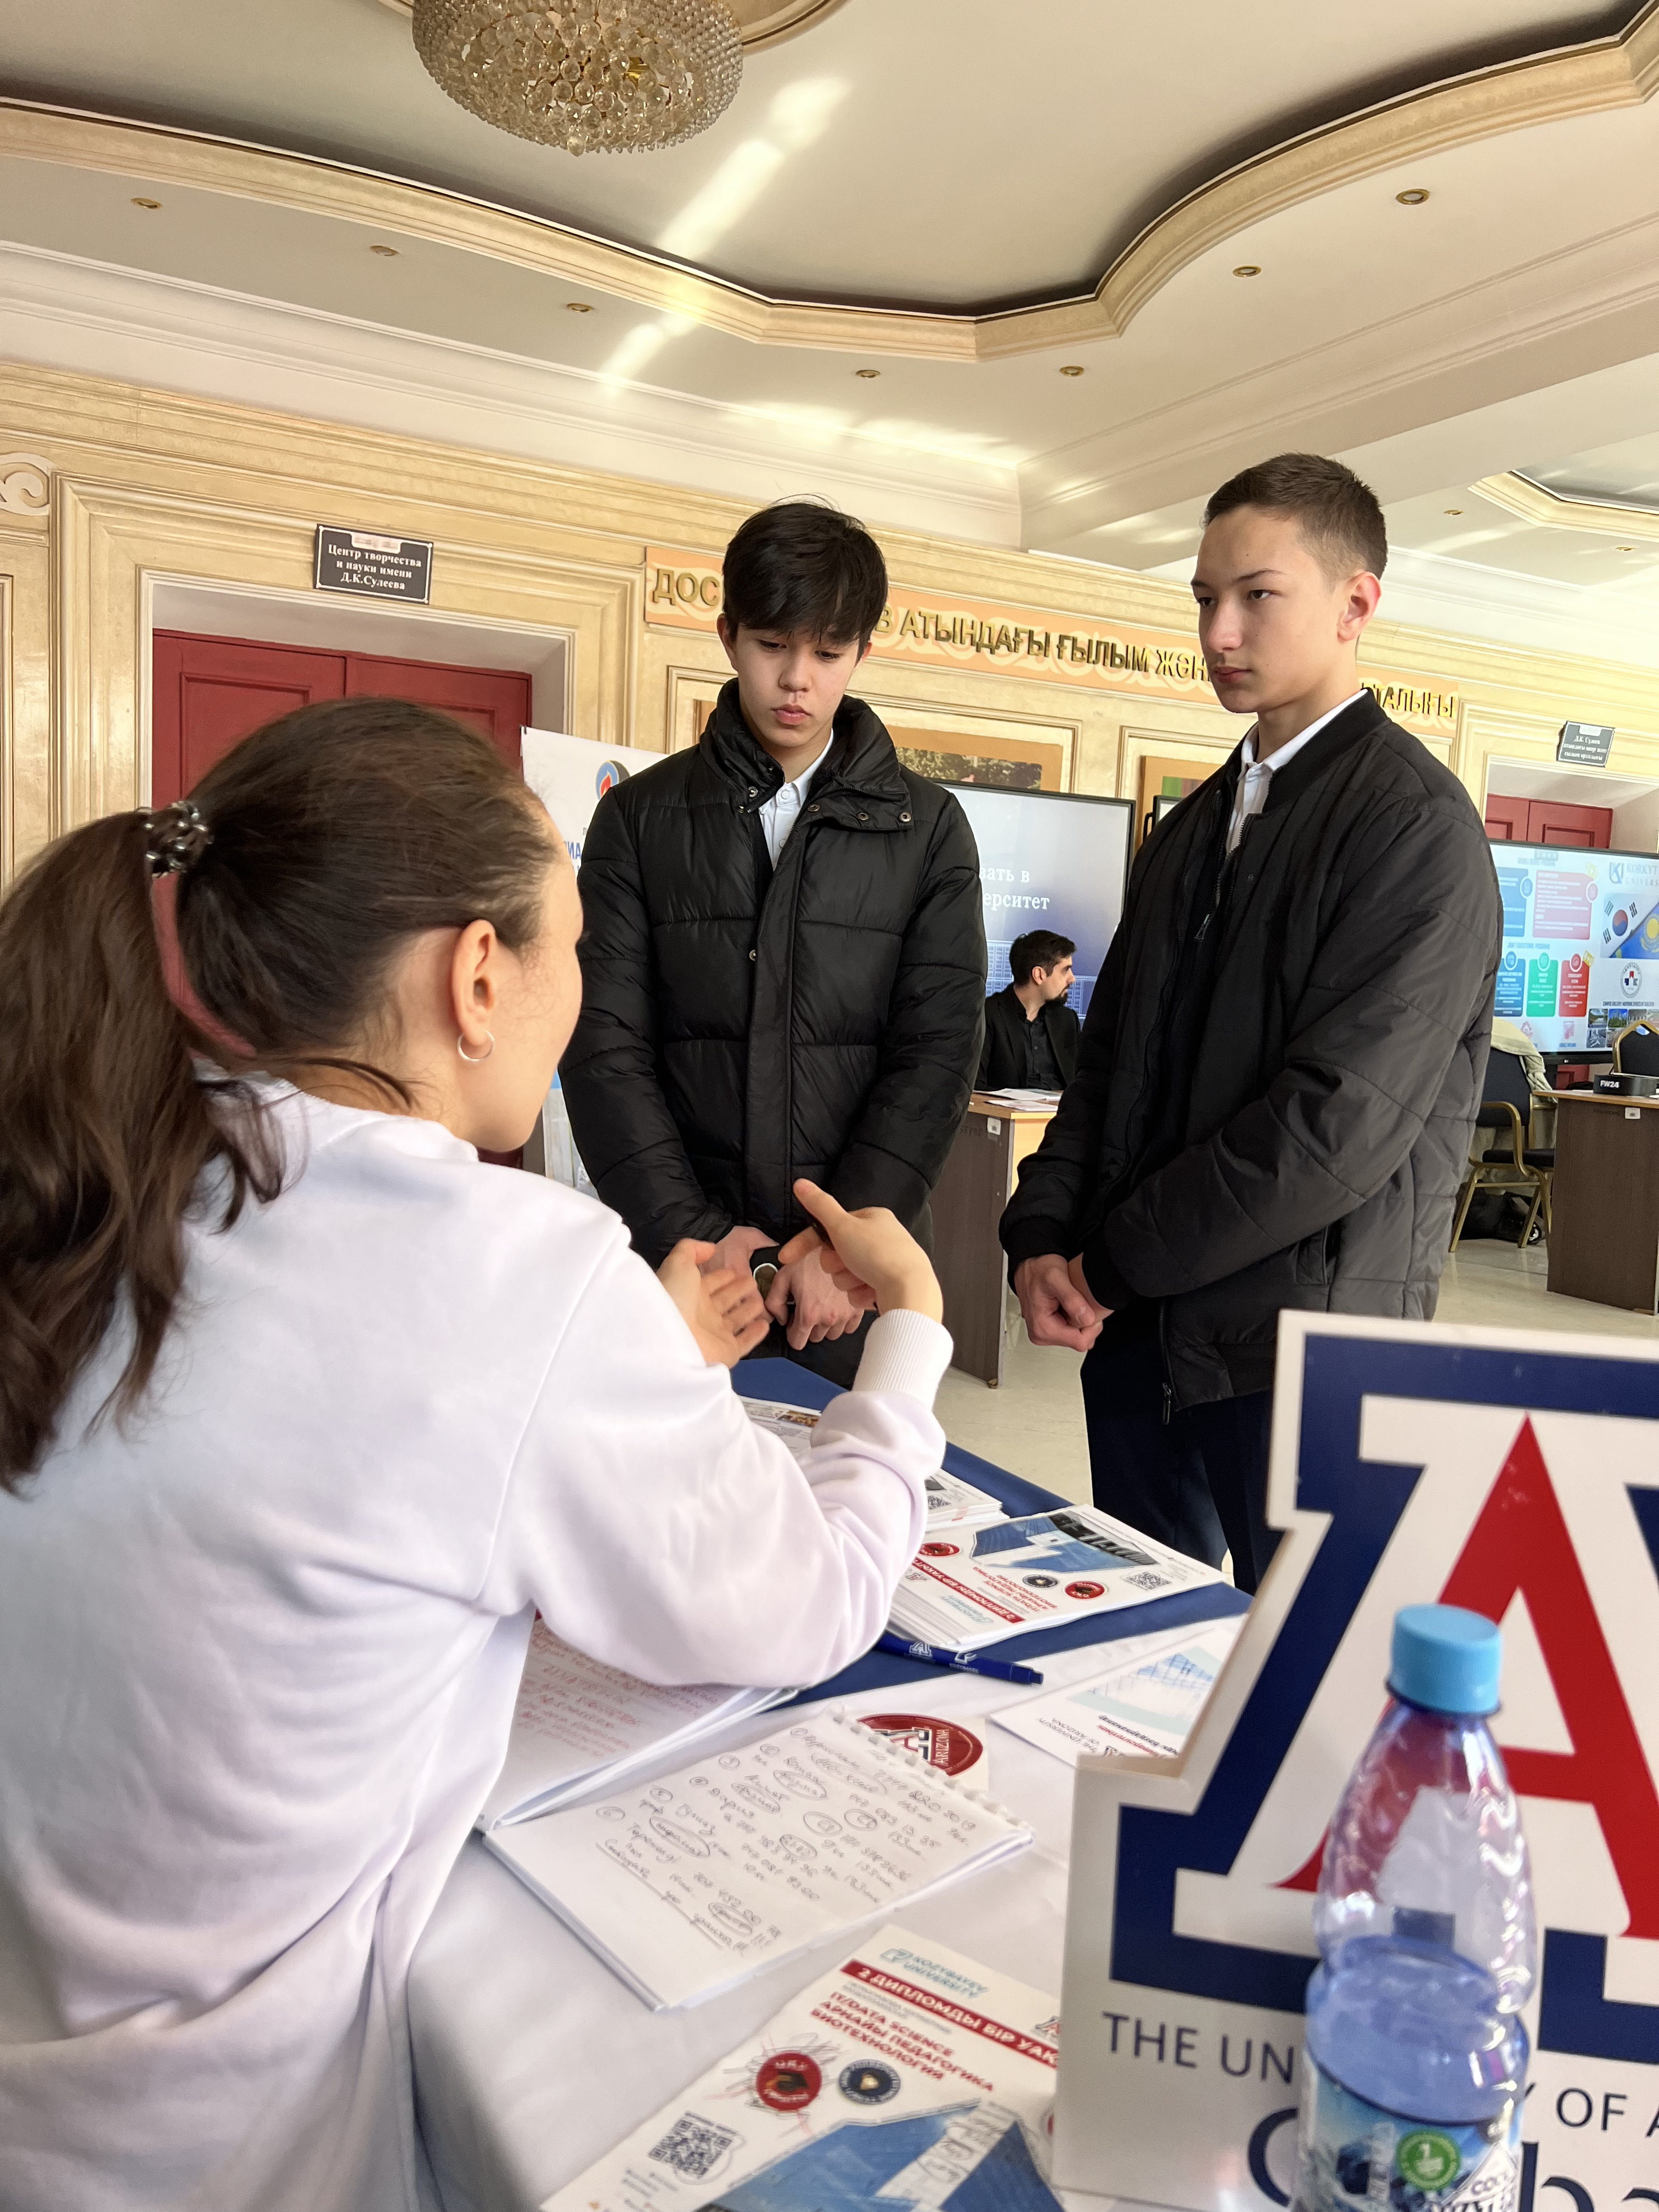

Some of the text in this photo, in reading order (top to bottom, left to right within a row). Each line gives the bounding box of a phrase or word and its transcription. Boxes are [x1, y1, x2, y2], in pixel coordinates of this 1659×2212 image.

[328, 544, 422, 567] Центр творчества
[346, 562, 377, 573] науки
[380, 568, 413, 578] имени
[340, 572, 405, 590] Д.К.Сулеева
[653, 568, 720, 606] ДОС
[900, 609, 1050, 657] АТЫНДАҒЫ
[1057, 634, 1150, 673] ҒЫЛЫМ
[1156, 649, 1210, 681] ЖӘН
[1362, 682, 1457, 718] ТАЛЫҒЫ
[979, 866, 1030, 883] вать в
[1626, 878, 1659, 887] UNIVERS
[983, 893, 1050, 911] ерситет
[1600, 1080, 1620, 1088] FW24
[933, 1729, 949, 1767] ARIZONA
[859, 1968, 871, 1979] 2
[870, 1974, 982, 2029] ДИПЛОМДЫ
[983, 2023, 1015, 2042] БІР
[830, 1992, 886, 2025] IT/DATA
[889, 2021, 955, 2057] SCIENCE
[1102, 2010, 1199, 2068] THE
[820, 2001, 888, 2037] АРНАЙЫ
[889, 2033, 994, 2092] ПЕДАГОГИКА
[1556, 2087, 1628, 2132] OF
